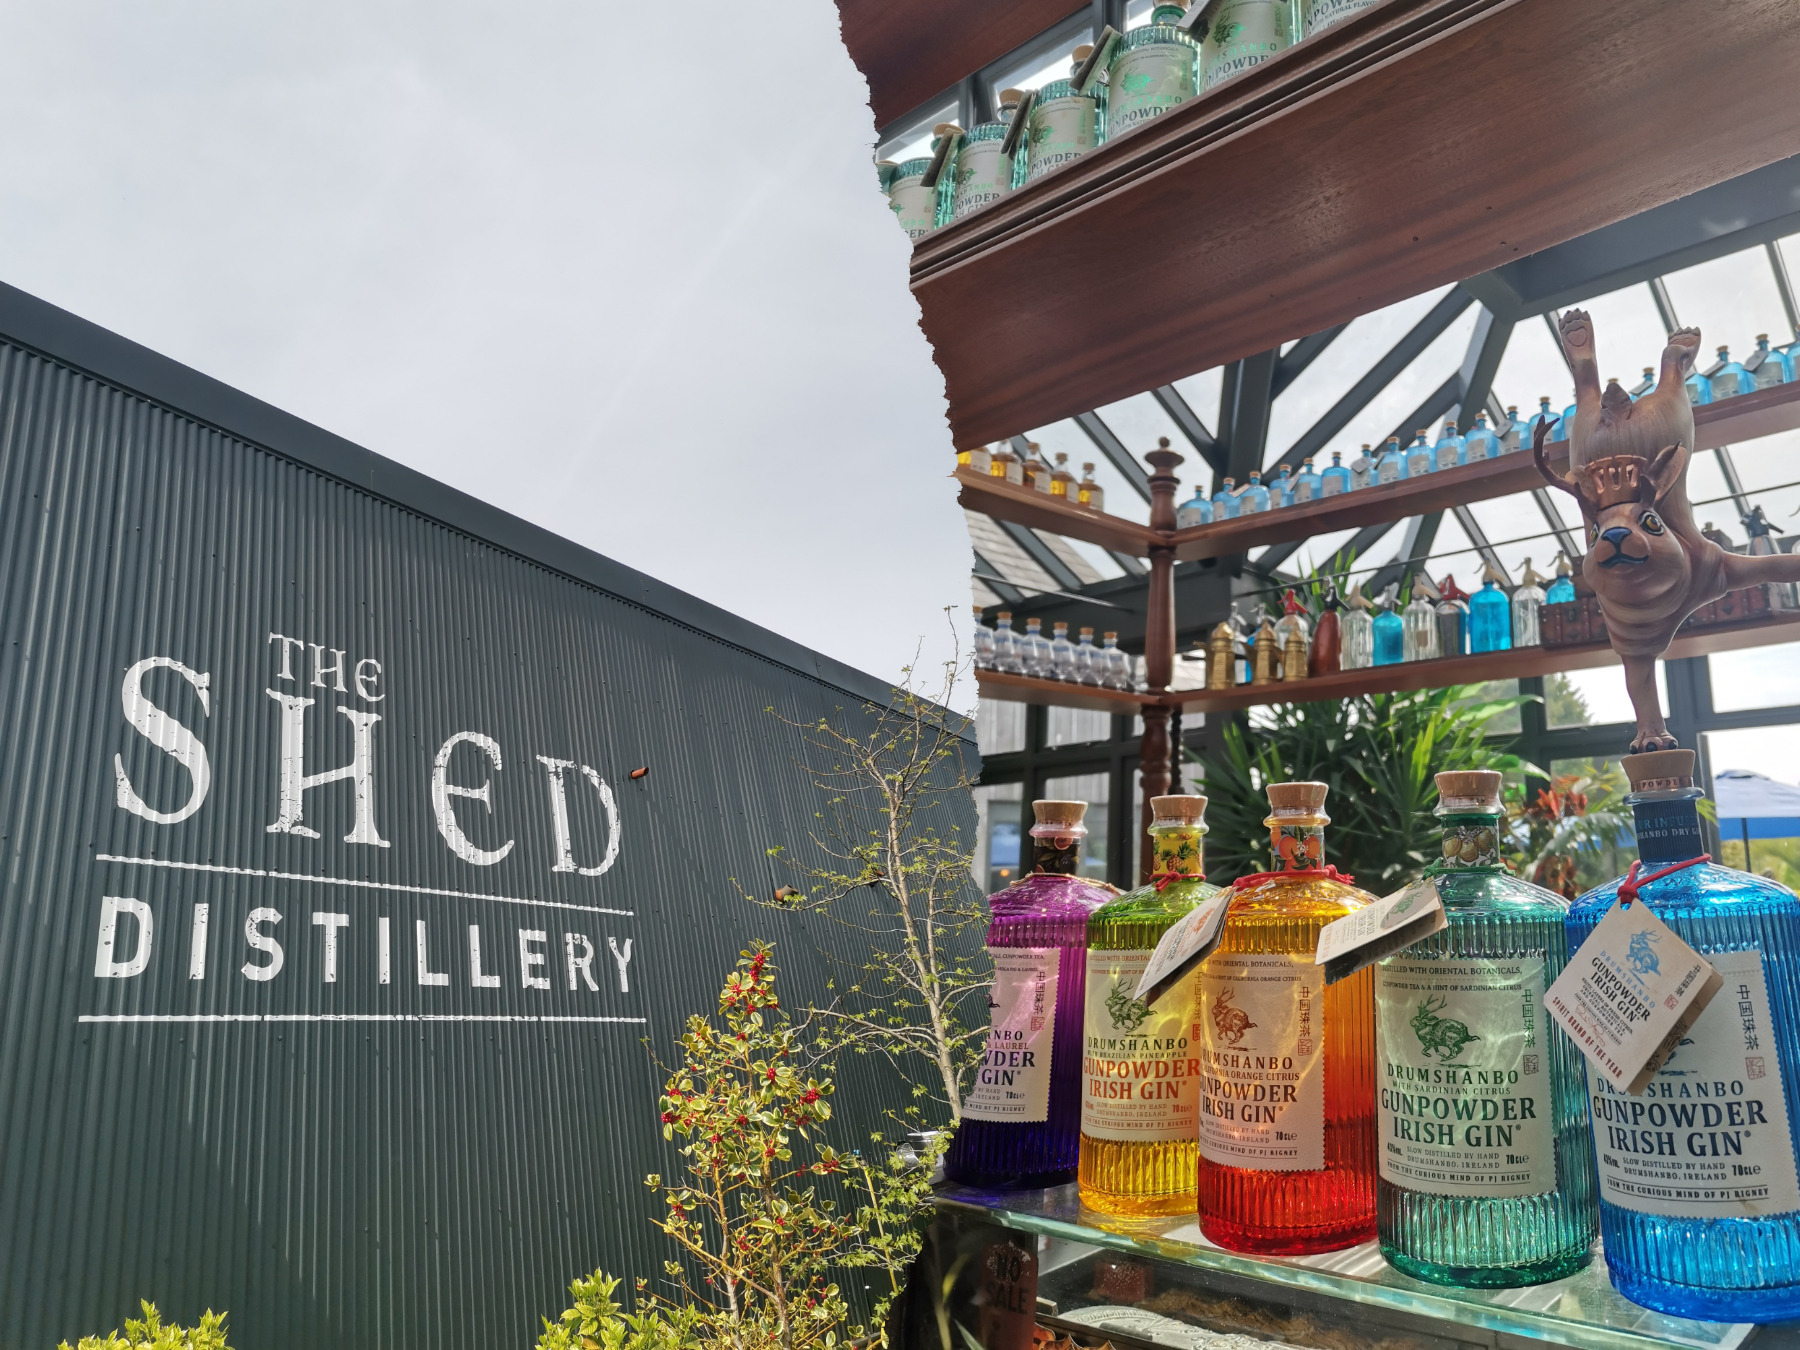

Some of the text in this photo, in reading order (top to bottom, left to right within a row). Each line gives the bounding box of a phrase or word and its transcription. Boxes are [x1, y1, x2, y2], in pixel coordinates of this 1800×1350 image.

[269, 632, 385, 702] THE
[114, 656, 622, 876] SHED
[1672, 828, 1690, 837] DRY
[94, 895, 633, 993] DISTILLERY
[1429, 967, 1468, 975] ORIENTAL
[1600, 950, 1656, 1009] DRUMSHANBO
[1460, 984, 1497, 992] SARDINIAN
[1590, 972, 1618, 1001] IRISH
[1591, 957, 1652, 1022] GUNPOWDER
[995, 1042, 1029, 1050] LAUREL
[1088, 1037, 1187, 1050] DRUMSHANBO
[1552, 996, 1570, 1018] SPIRIT
[1567, 1015, 1586, 1038] BRAND
[1585, 1036, 1595, 1047] OF
[1593, 1045, 1606, 1060] THE
[1606, 1057, 1623, 1079] YEAR
[1100, 1050, 1136, 1059] BRAZILIAN
[1140, 1051, 1187, 1059] PINEAPPLE
[1201, 1048, 1293, 1070] RUMSHANBO
[1084, 1056, 1200, 1079] GUNPOWDER
[1231, 1070, 1300, 1081] ORANGE CITRUS
[1388, 1063, 1519, 1085] DRUMSHANBO
[1089, 1079, 1133, 1100] IRISH
[1393, 1080, 1511, 1095] WITH SARDINIAN CITRUS
[1597, 1077, 1744, 1099] DRSHANBO
[1202, 1095, 1234, 1120] IRISH
[1381, 1087, 1537, 1121] GUNPOWDER
[1593, 1096, 1768, 1128] GUNPOWDER
[1167, 1119, 1193, 1127] RIGNEY
[1215, 1122, 1240, 1132] DISTILLED
[1393, 1116, 1455, 1147] IRISH
[1239, 1135, 1270, 1144] IRELAND
[1607, 1125, 1677, 1156] IRISH
[1231, 1146, 1246, 1154] MIND
[1407, 1146, 1422, 1155] SLOW
[1425, 1149, 1462, 1159] DISTILLED
[1464, 1152, 1474, 1160] BY
[1477, 1152, 1500, 1160] HAND
[1462, 1161, 1500, 1169] IRELAND
[1623, 1156, 1639, 1166] SLOW
[1642, 1159, 1683, 1170] DISTILLED
[1686, 1162, 1696, 1170] BY
[1700, 1162, 1725, 1170] HAND
[1401, 1166, 1412, 1175] THE
[1415, 1168, 1446, 1180] CURIOUS
[1450, 1173, 1471, 1182] MIND
[1489, 1175, 1497, 1183] PJ
[1501, 1173, 1531, 1182] RIGNEY
[1684, 1171, 1727, 1180] IRELAND
[1622, 1184, 1635, 1193] THE
[1637, 1186, 1672, 1197] CURIOUS
[1676, 1190, 1700, 1199] MIND
[1704, 1191, 1715, 1199] OF
[1720, 1191, 1730, 1200] PJ
[1734, 1188, 1769, 1198] RIGNEY
